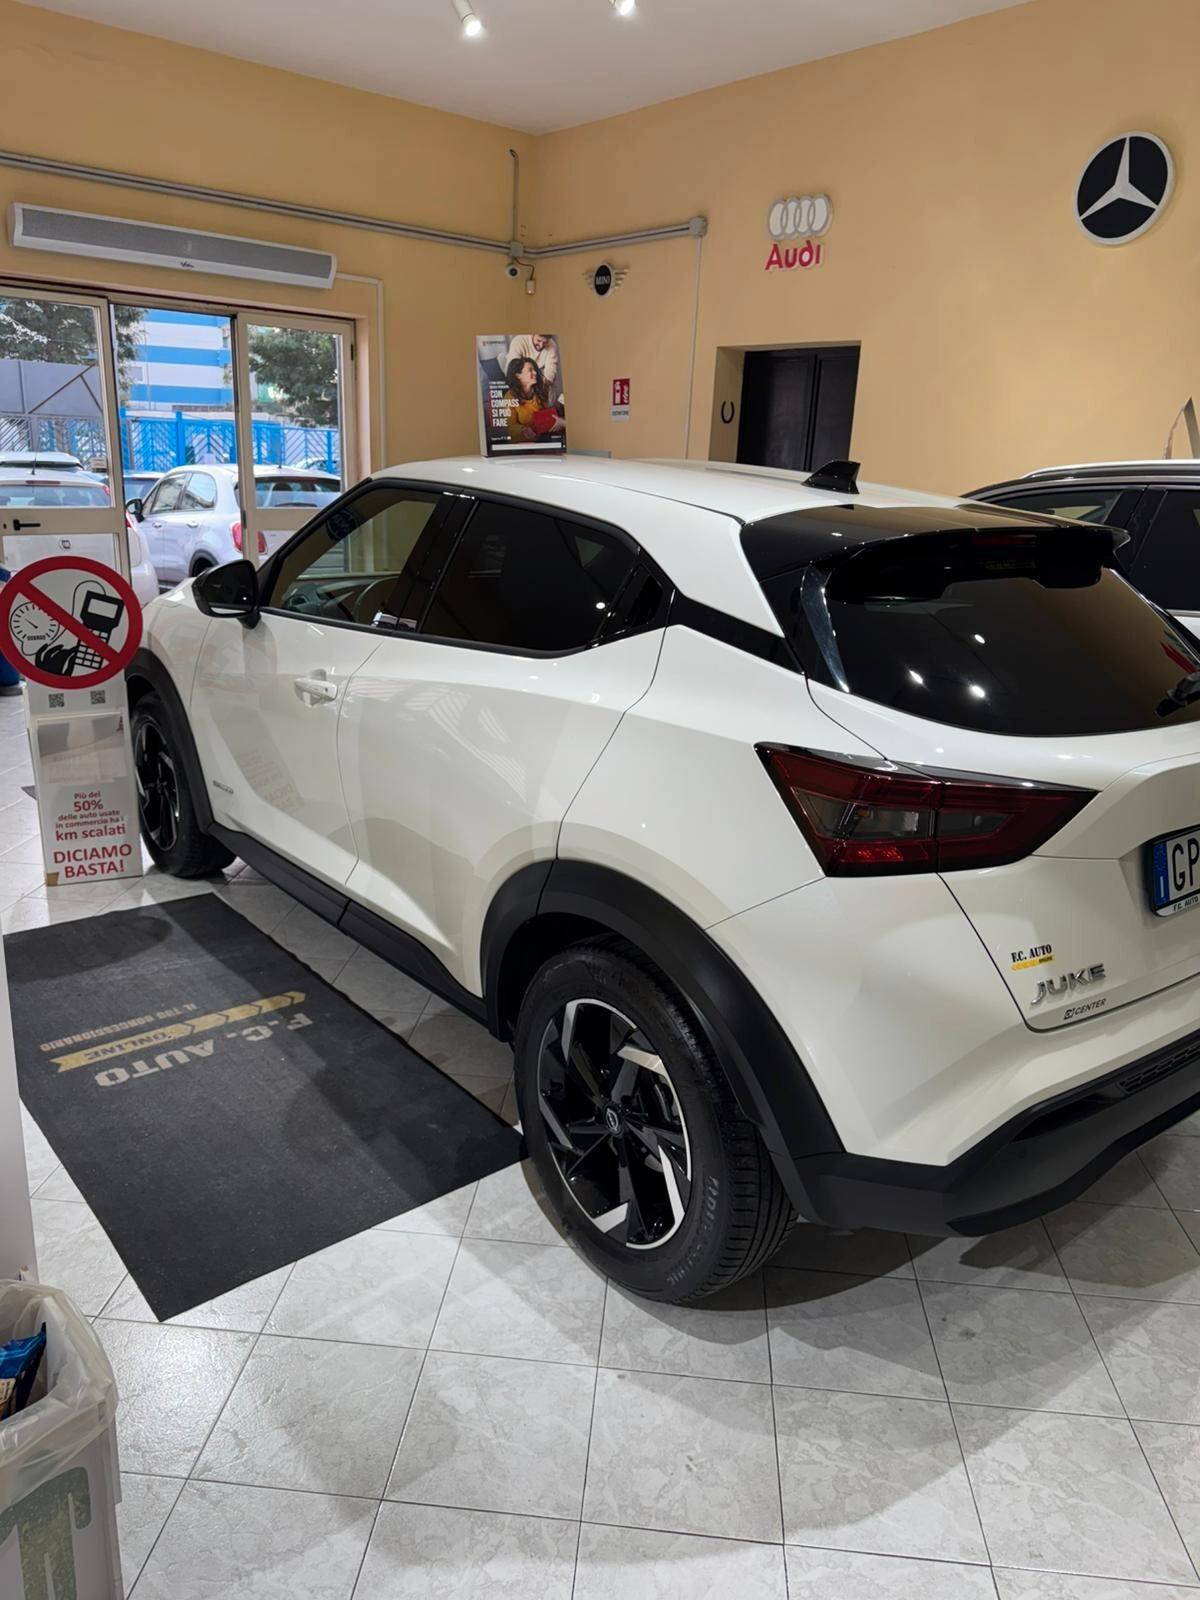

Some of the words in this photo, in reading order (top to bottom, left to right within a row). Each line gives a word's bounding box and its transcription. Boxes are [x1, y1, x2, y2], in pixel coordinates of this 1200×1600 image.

[765, 239, 821, 270] Audi
[490, 390, 503, 398] CON
[491, 398, 520, 408] COMPASS
[493, 418, 508, 427] FARE
[74, 800, 104, 812] 50%
[58, 813, 78, 821] delle
[99, 809, 120, 817] usate
[56, 821, 63, 829] in
[65, 818, 108, 828] commercio
[56, 830, 78, 841] km
[82, 823, 126, 838] scalati
[53, 843, 132, 864] DICIAMO
[64, 859, 125, 878] BASTA!
[1172, 837, 1199, 892] GP
[1184, 895, 1199, 907] AUTO
[1029, 944, 1052, 959] AUTO
[1030, 962, 1106, 1006] JUKE
[94, 1039, 215, 1087] AUTO
